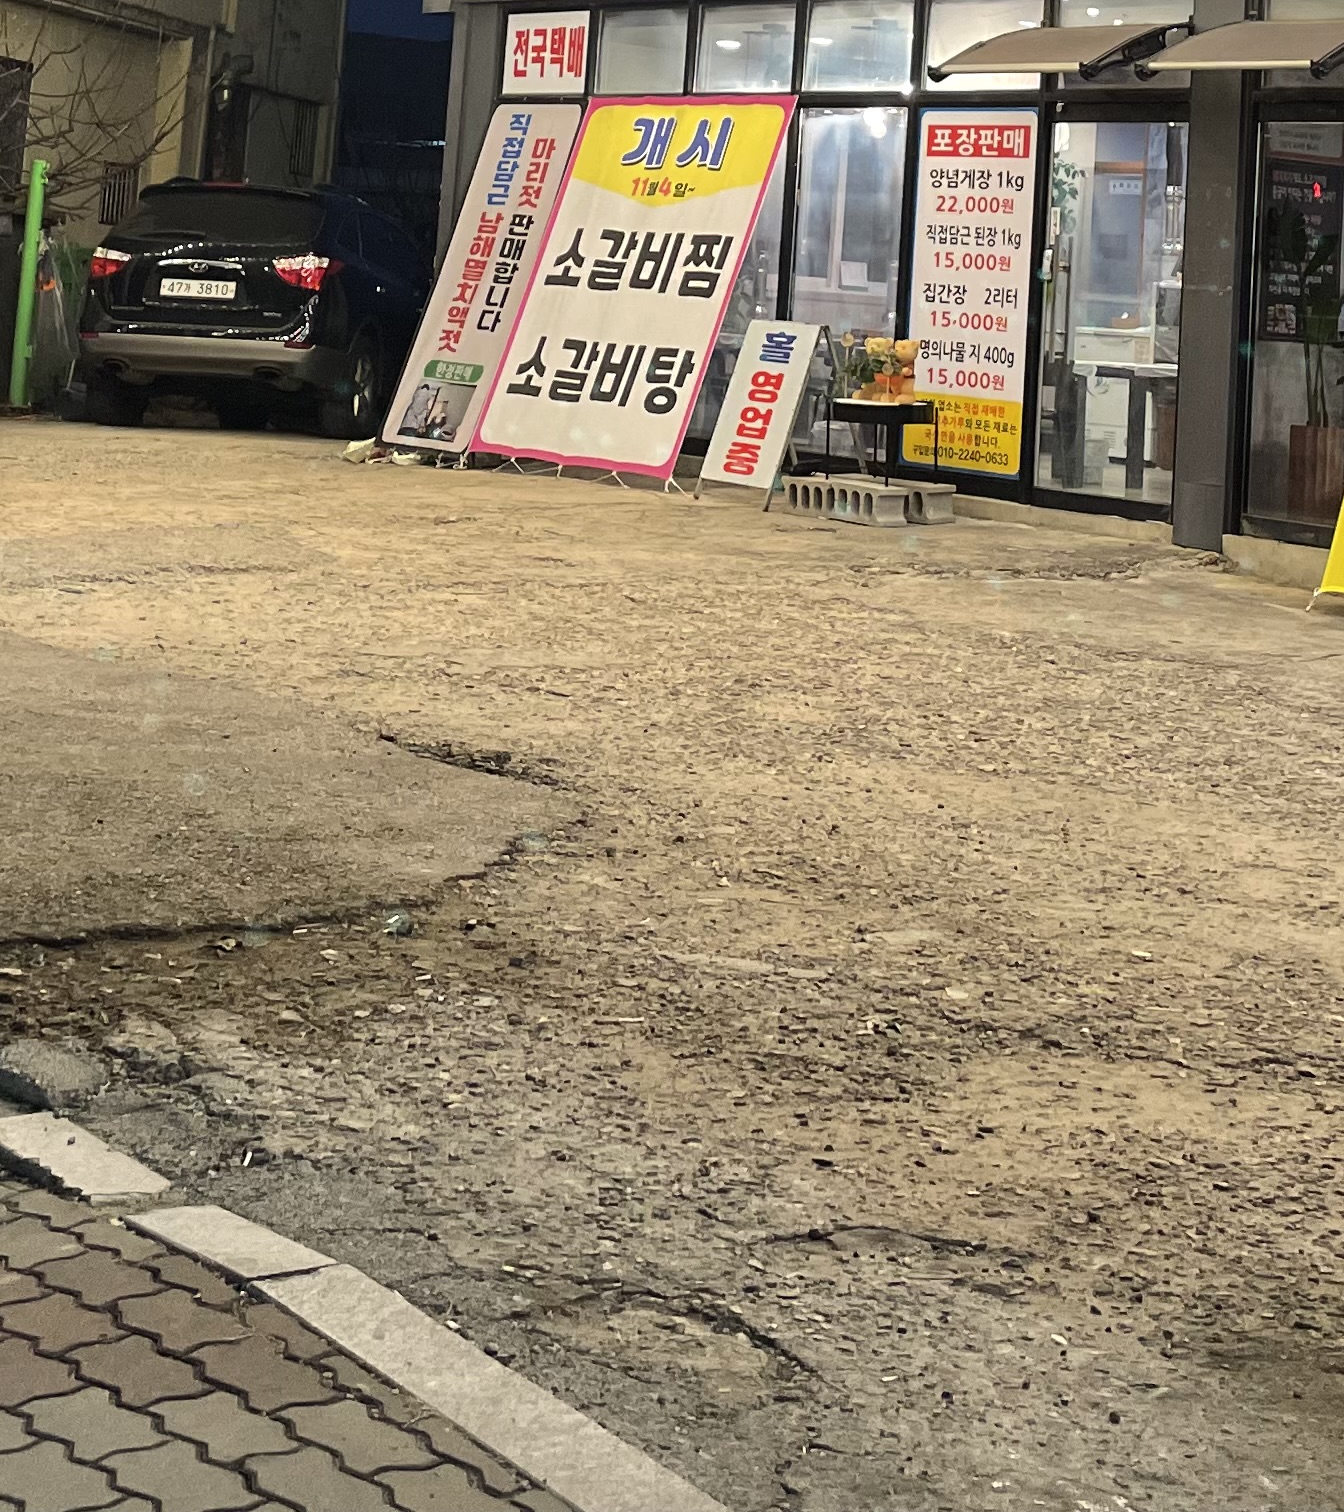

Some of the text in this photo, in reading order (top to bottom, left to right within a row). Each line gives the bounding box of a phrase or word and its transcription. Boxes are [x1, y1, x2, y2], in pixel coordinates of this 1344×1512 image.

[512, 25, 583, 80] 전국택배
[621, 116, 735, 170] 개시
[931, 128, 1026, 157] 포장판매
[929, 168, 1025, 192] 양념게장 1kg
[935, 195, 1015, 215] 22,000원
[926, 224, 1022, 250] 직접담근 된장 1kg
[544, 228, 734, 298] 소갈비찜
[933, 251, 1012, 272] 15,000원
[922, 283, 1018, 309] 집간장 2리터
[984, 346, 1015, 368] 400g
[508, 335, 695, 415] 소갈비탕
[927, 367, 1006, 392] 15,000원
[723, 330, 796, 476] 홀 영업중
